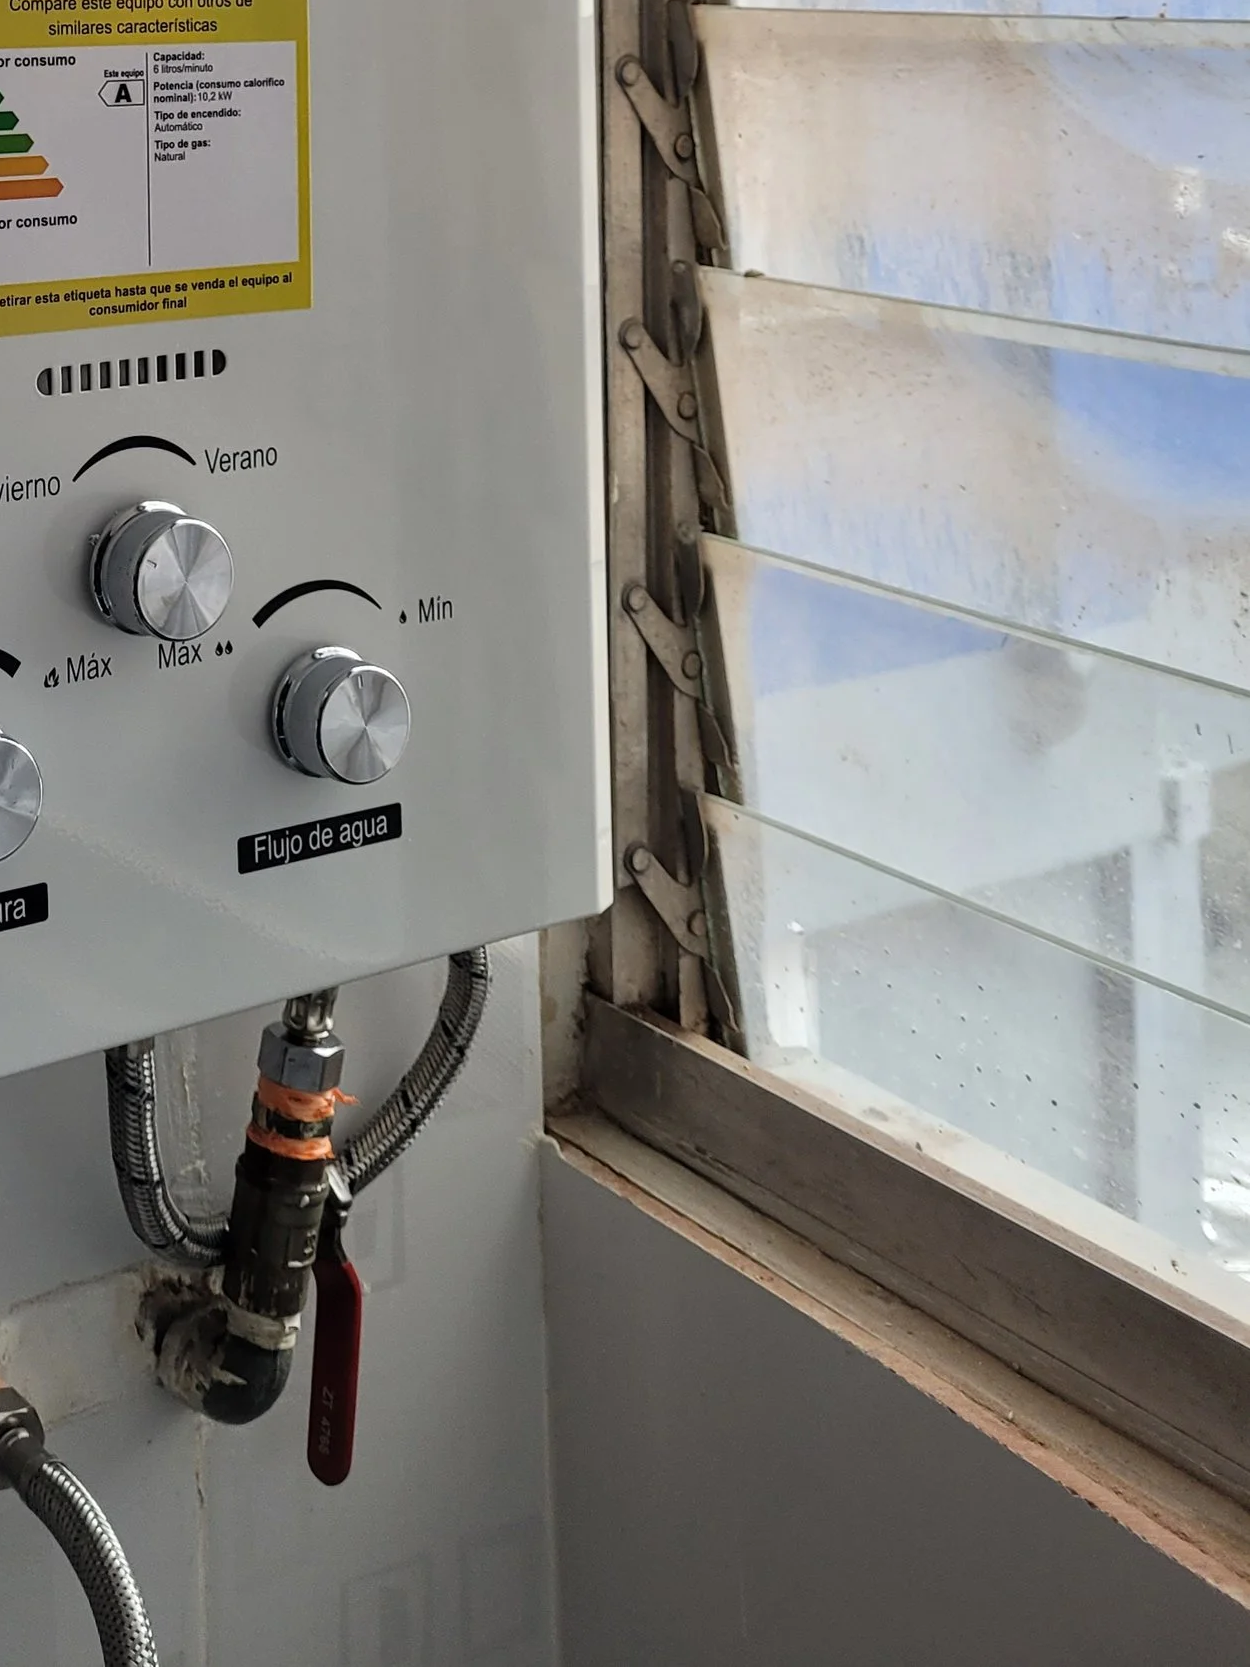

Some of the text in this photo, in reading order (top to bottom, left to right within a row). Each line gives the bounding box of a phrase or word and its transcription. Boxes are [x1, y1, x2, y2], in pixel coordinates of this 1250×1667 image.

[48, 18, 217, 36] similares características
[14, 56, 76, 67] consumo
[153, 51, 204, 63] Capacidad:
[104, 69, 144, 78] Este equipo
[153, 63, 213, 74] 6 litros/minuto
[153, 81, 193, 91] Potencia
[196, 80, 241, 91] (consumo
[115, 83, 132, 103] A
[218, 91, 232, 100] kW
[154, 108, 241, 122] Tipo de encendido:
[154, 121, 203, 132] Automático
[154, 139, 211, 151] Tipo de gas:
[154, 151, 185, 162] Natural
[16, 215, 77, 228] consumo
[35, 292, 60, 304] esta
[64, 288, 111, 303] etiqueta
[115, 285, 146, 297] hasta
[150, 284, 171, 297] que
[175, 283, 188, 292] se
[191, 278, 225, 290] venda
[229, 276, 238, 287] el
[241, 274, 279, 288] equipo
[283, 272, 292, 283] al
[89, 296, 187, 316] consumidor final
[204, 447, 277, 474] Verano
[419, 596, 452, 623] Mín
[158, 638, 202, 669] Máx
[67, 652, 112, 684] Máx
[254, 815, 387, 864] Flujo de agua
